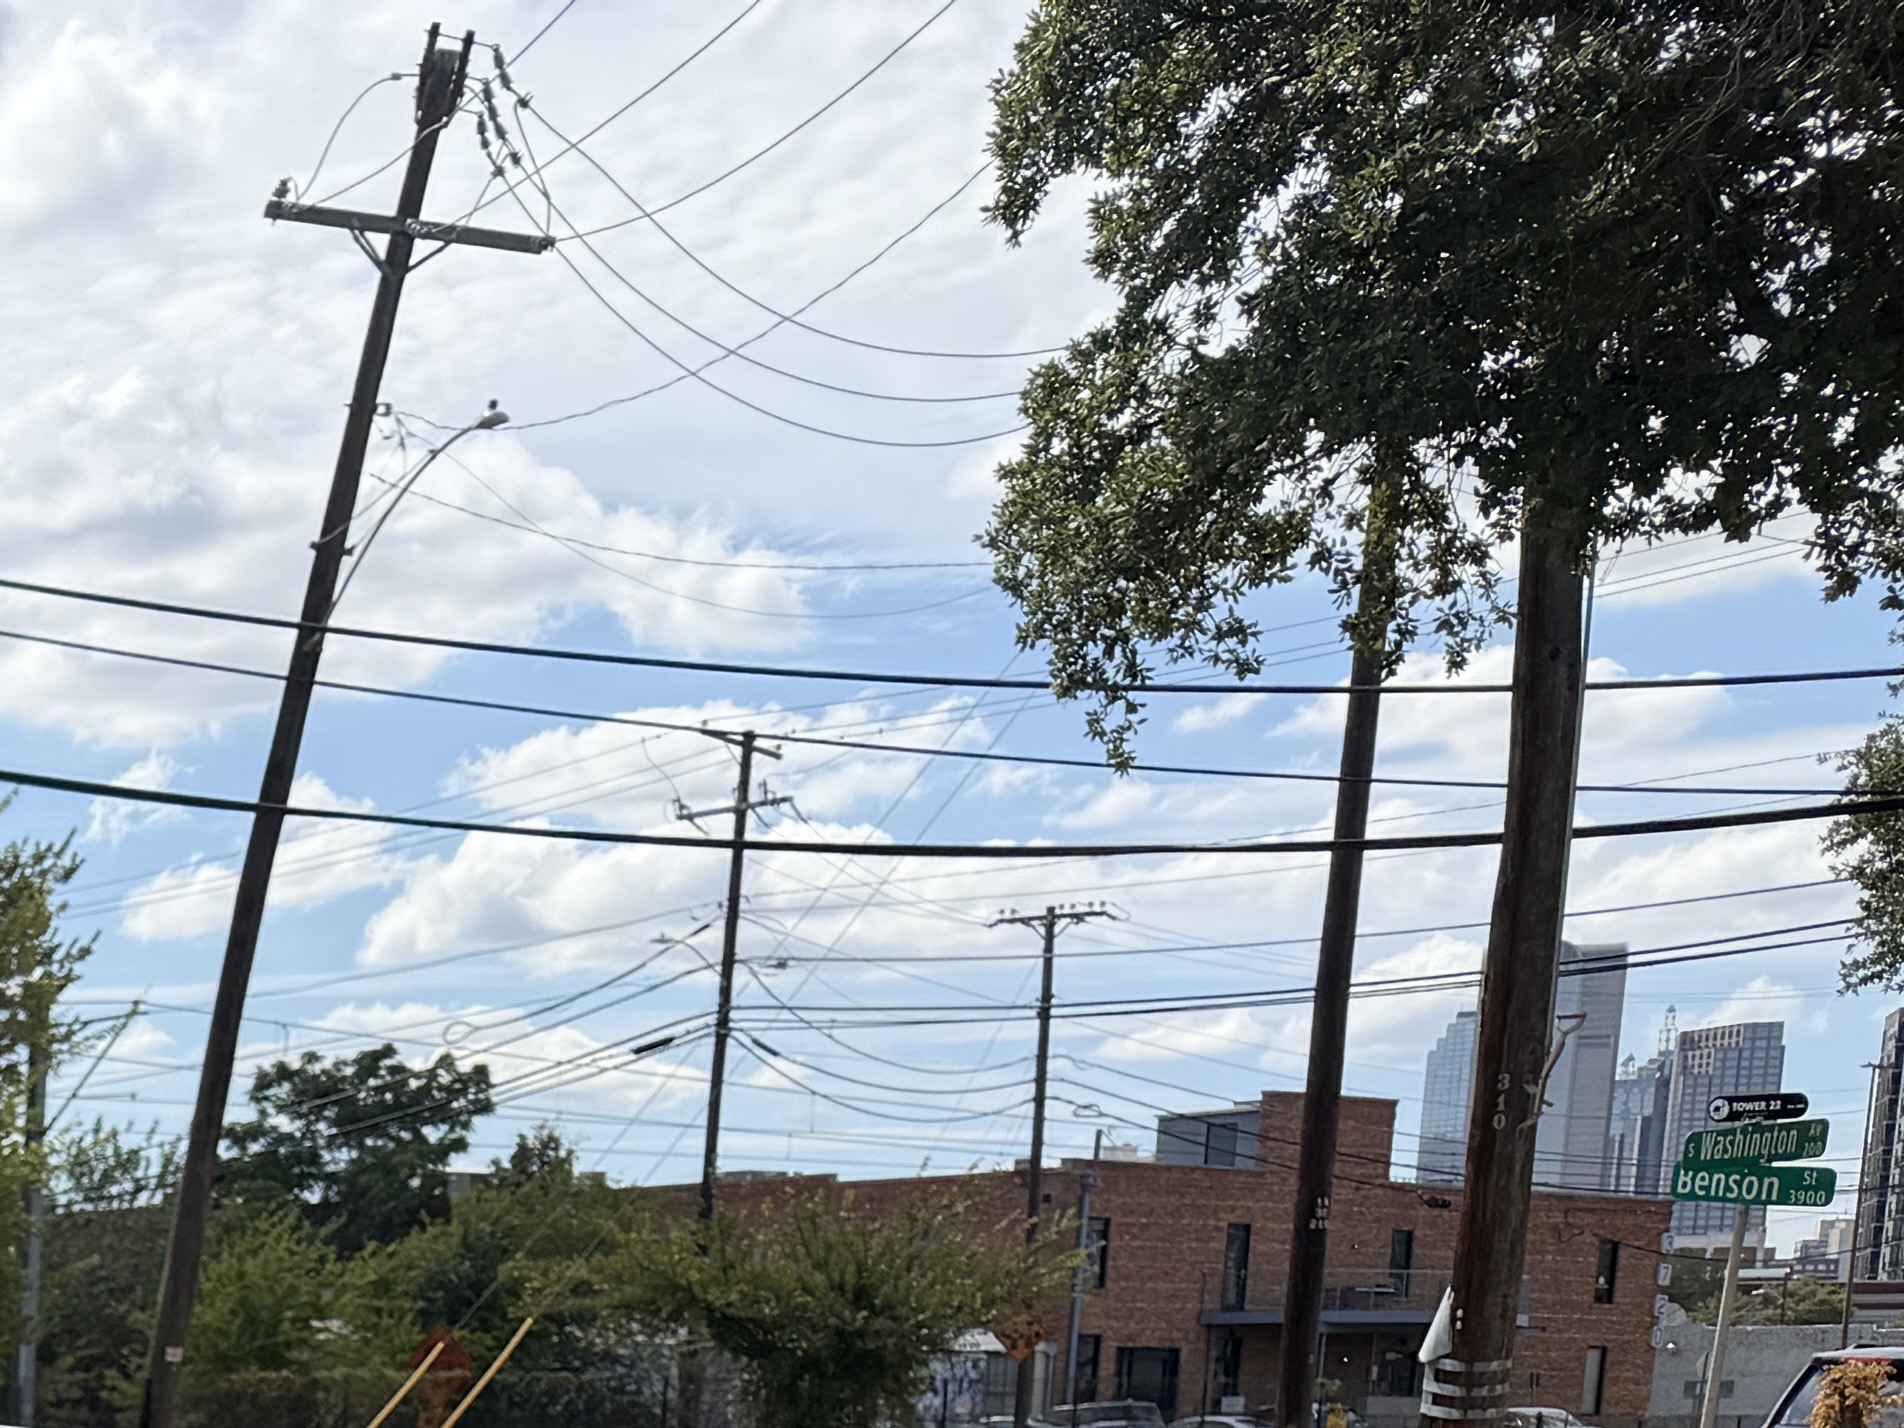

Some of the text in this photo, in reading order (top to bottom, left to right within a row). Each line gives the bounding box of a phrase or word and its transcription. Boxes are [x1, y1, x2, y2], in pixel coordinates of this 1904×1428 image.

[1492, 1073, 1512, 1131] 310
[1688, 1143, 1695, 1157] S
[1701, 1126, 1797, 1162] Washington
[1677, 1168, 1817, 1200] Benson St
[1788, 1190, 1825, 1205] 3900
